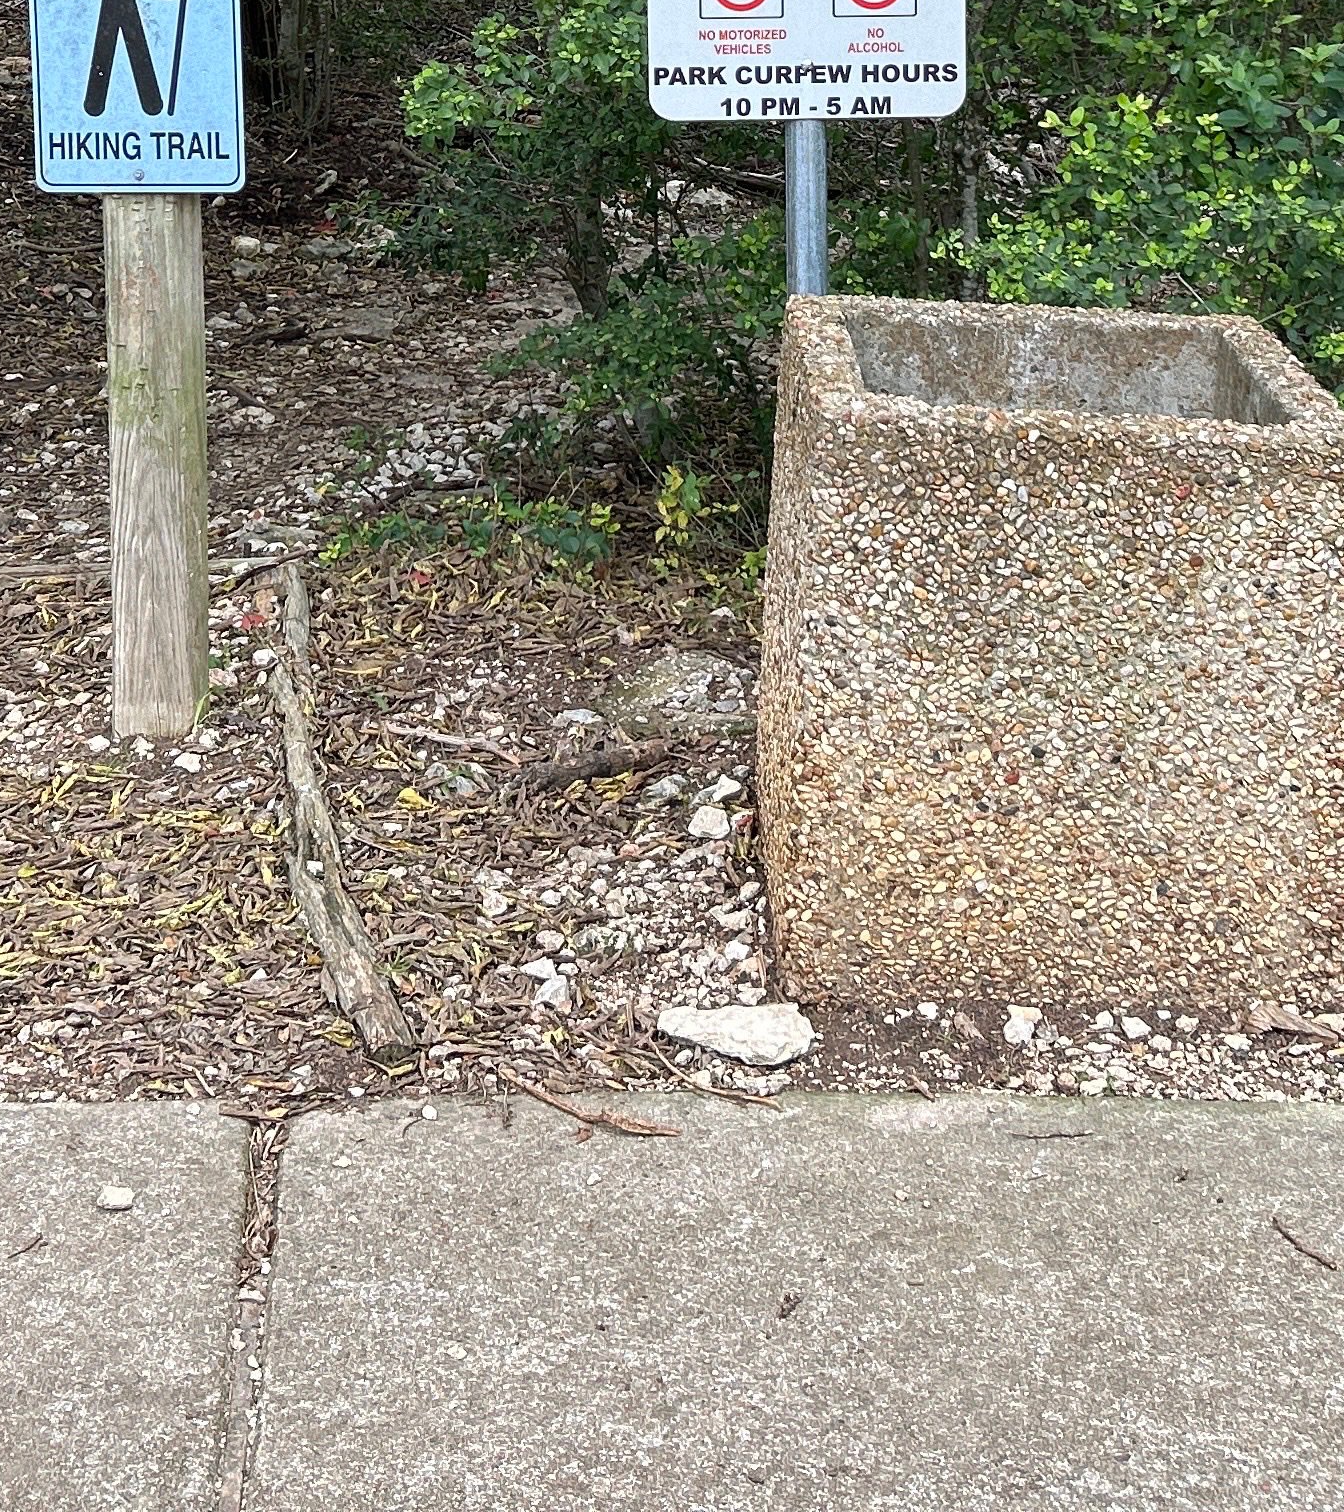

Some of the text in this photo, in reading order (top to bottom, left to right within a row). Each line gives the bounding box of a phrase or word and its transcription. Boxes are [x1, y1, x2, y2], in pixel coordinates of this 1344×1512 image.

[699, 30, 786, 40] NO MOTORIZED
[868, 28, 884, 38] NO
[714, 44, 771, 54] VEHICLES
[848, 42, 904, 53] ALCOHOL
[654, 64, 957, 85] PARK CURFEW HOURS
[721, 98, 751, 116] 10
[762, 98, 799, 115] PM
[826, 97, 841, 115] 5
[850, 96, 891, 114] AM
[49, 132, 229, 160] HIKING TRAIL
